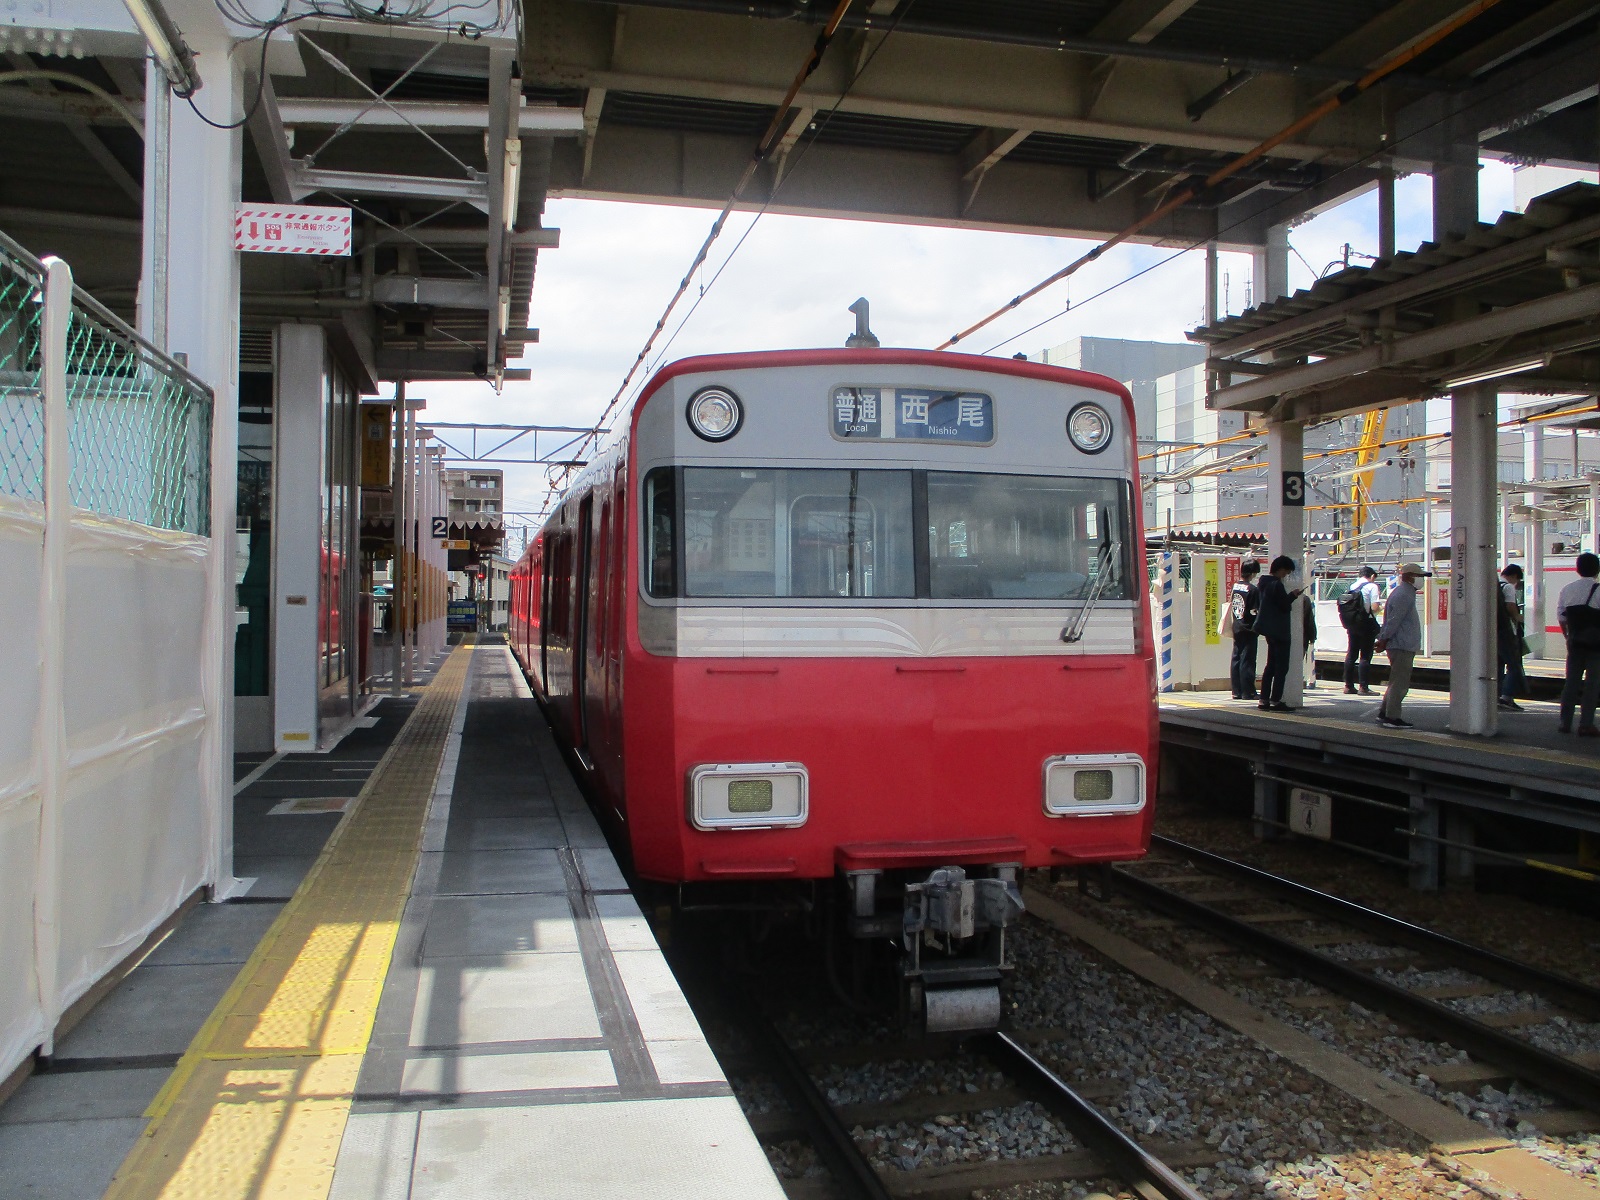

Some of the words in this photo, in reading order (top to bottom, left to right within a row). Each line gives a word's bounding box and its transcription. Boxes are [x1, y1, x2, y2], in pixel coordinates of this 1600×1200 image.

[285, 222, 340, 232] 非常通報ボタン
[835, 392, 877, 423] 普通
[901, 394, 984, 428] 西尾
[844, 423, 868, 433] Local
[928, 425, 958, 436] Nishio
[1286, 476, 1302, 500] 3
[433, 519, 447, 535] 2
[1457, 543, 1465, 570] Shin
